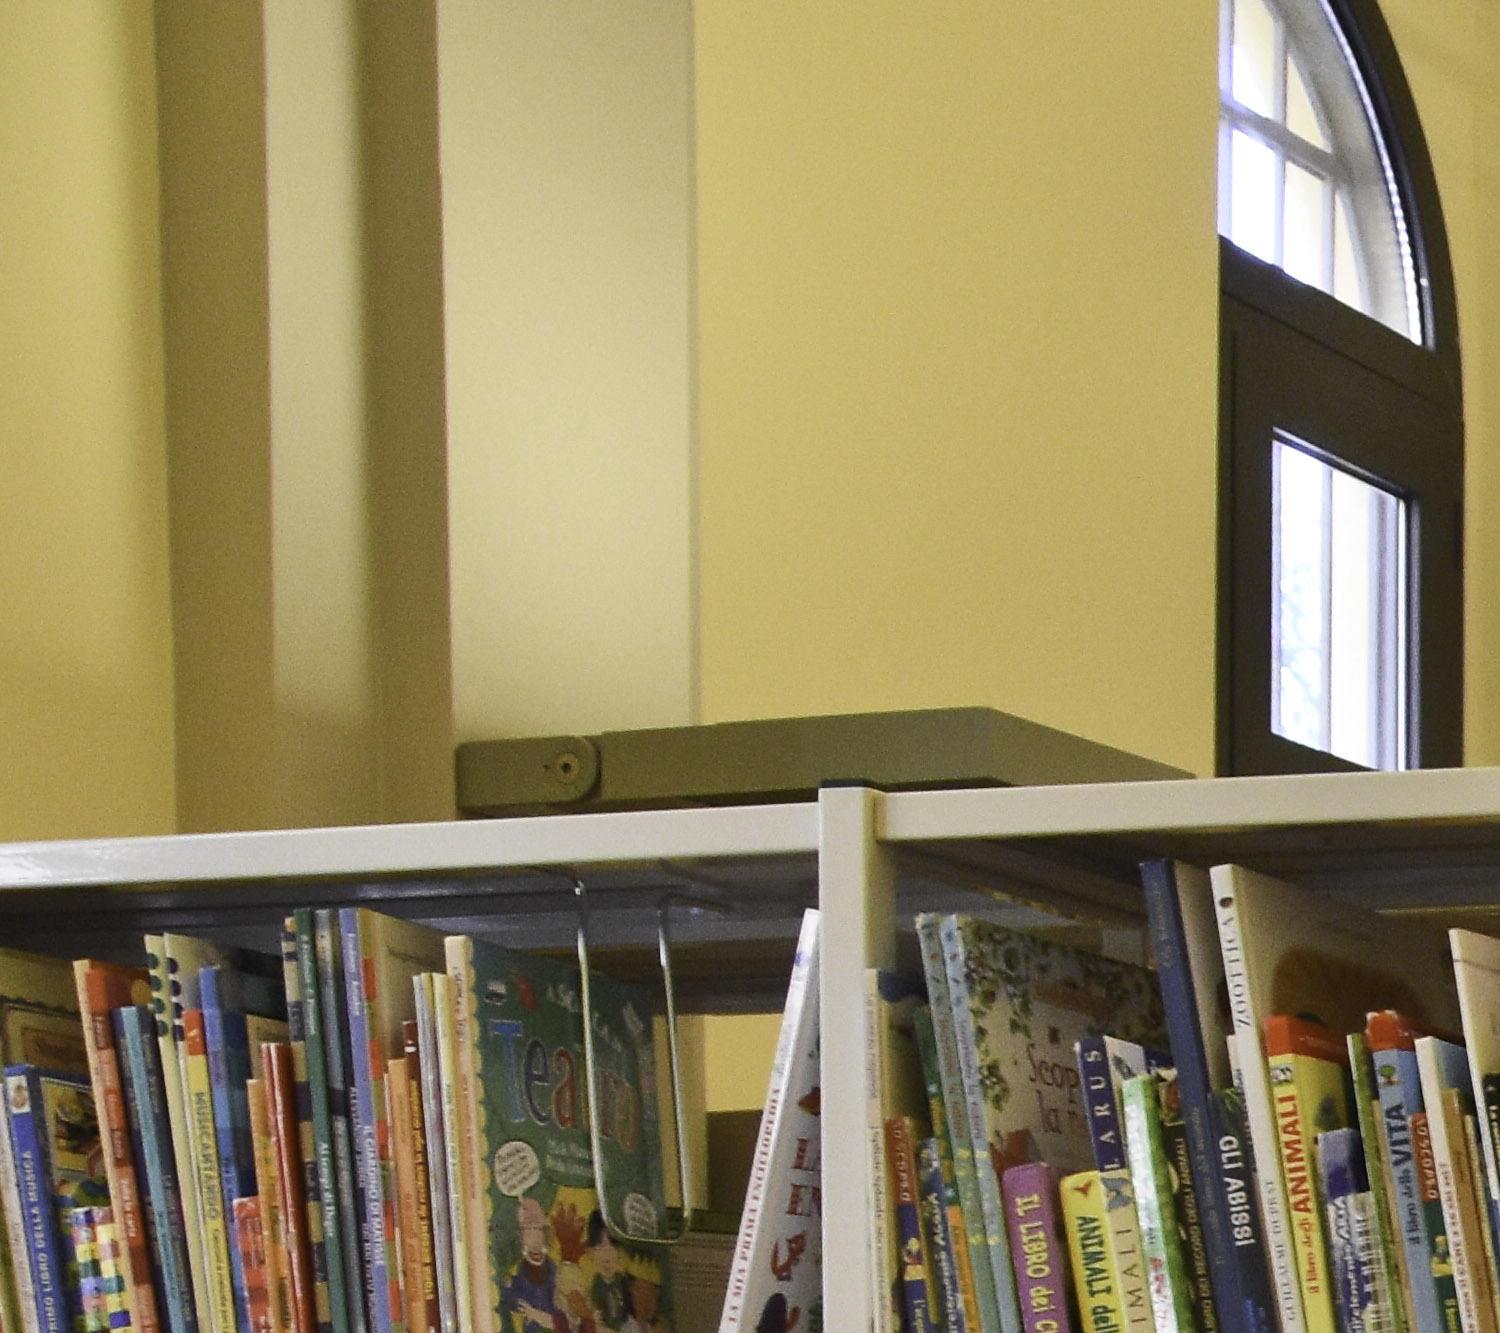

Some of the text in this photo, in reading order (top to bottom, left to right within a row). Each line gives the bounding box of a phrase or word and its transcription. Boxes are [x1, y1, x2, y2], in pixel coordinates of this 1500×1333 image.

[1276, 1094, 1312, 1214] ANIMALI
[1383, 1102, 1409, 1167] VITA
[21, 1150, 41, 1211] MUSICA
[737, 1207, 758, 1260] PRIMA
[748, 1086, 782, 1200] ENCICLOPEDIA
[1218, 1135, 1257, 1247] GLI ABISSI
[29, 1215, 44, 1250] DELLA
[1014, 1193, 1042, 1217] IL
[34, 1252, 49, 1292] LIBRO
[1019, 1221, 1049, 1278] LIBRO
[1078, 1215, 1114, 1299] ANIMALI
[1029, 1286, 1054, 1312] dei
